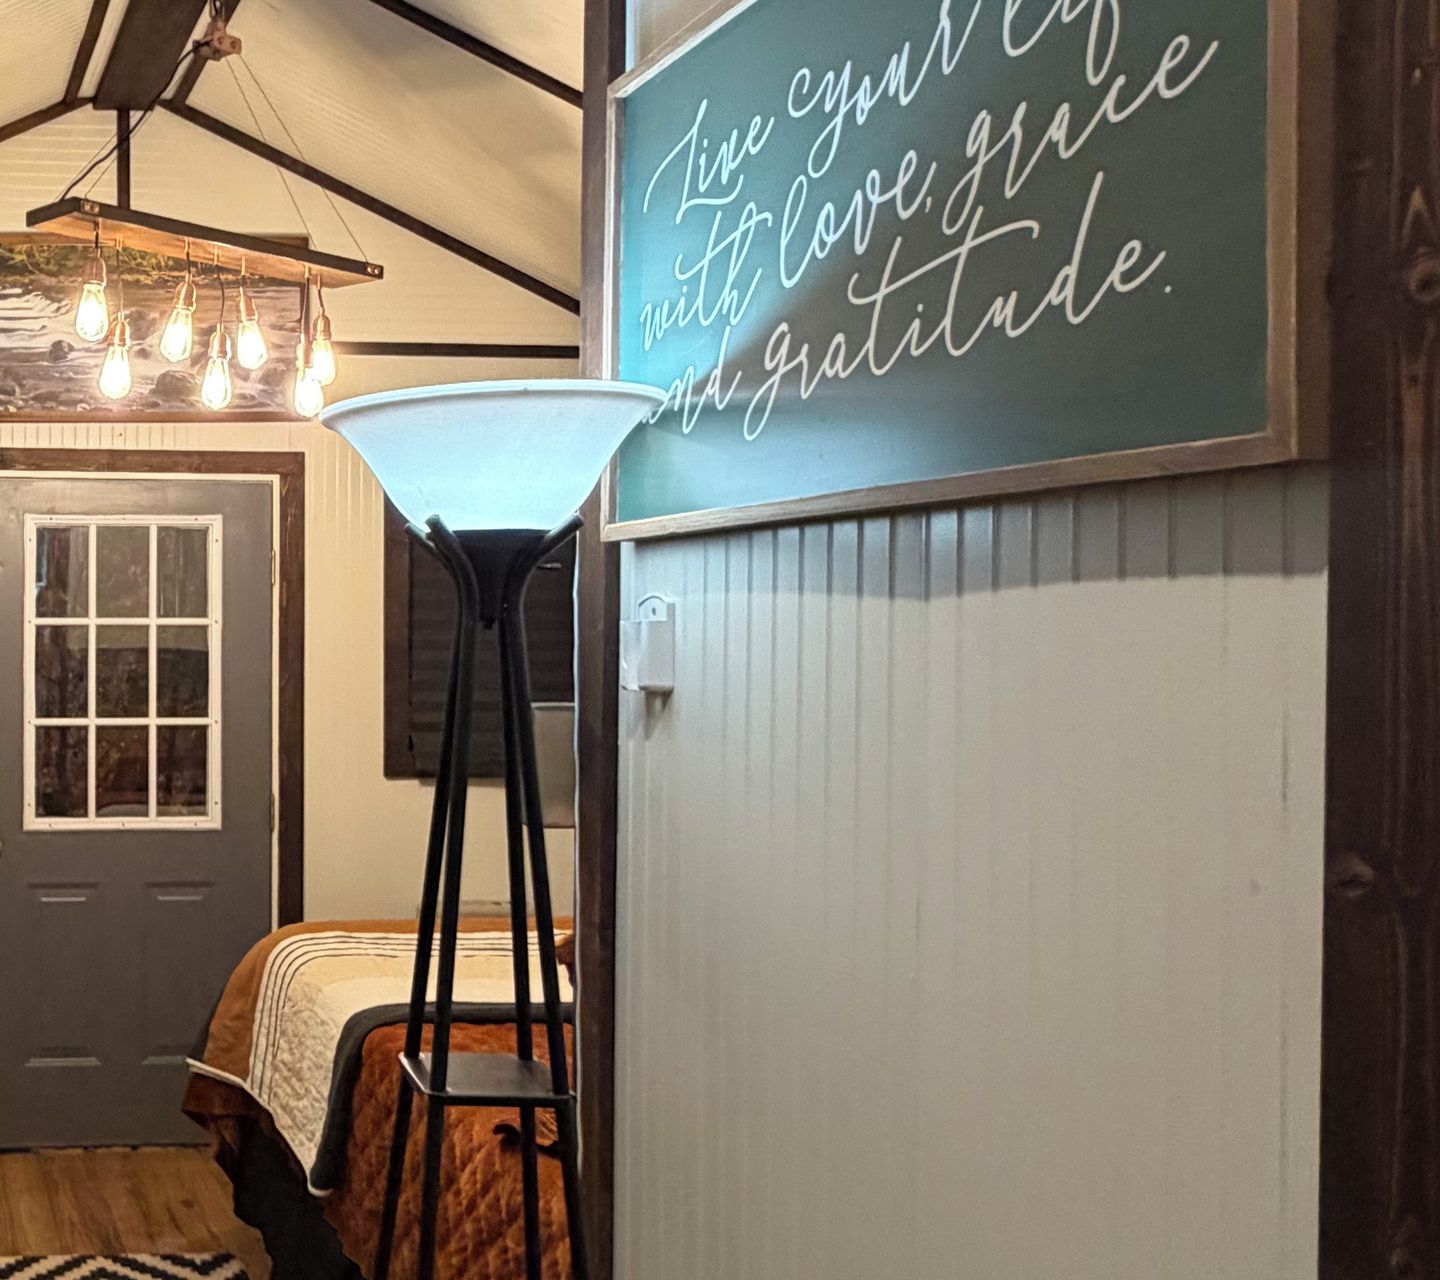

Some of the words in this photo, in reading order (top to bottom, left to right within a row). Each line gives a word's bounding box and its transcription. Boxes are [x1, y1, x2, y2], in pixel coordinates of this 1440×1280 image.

[639, 201, 774, 352] with
[778, 149, 938, 290] love,
[942, 33, 1219, 235] grace
[643, 99, 775, 222] Live
[743, 171, 1173, 441] gratitude.
